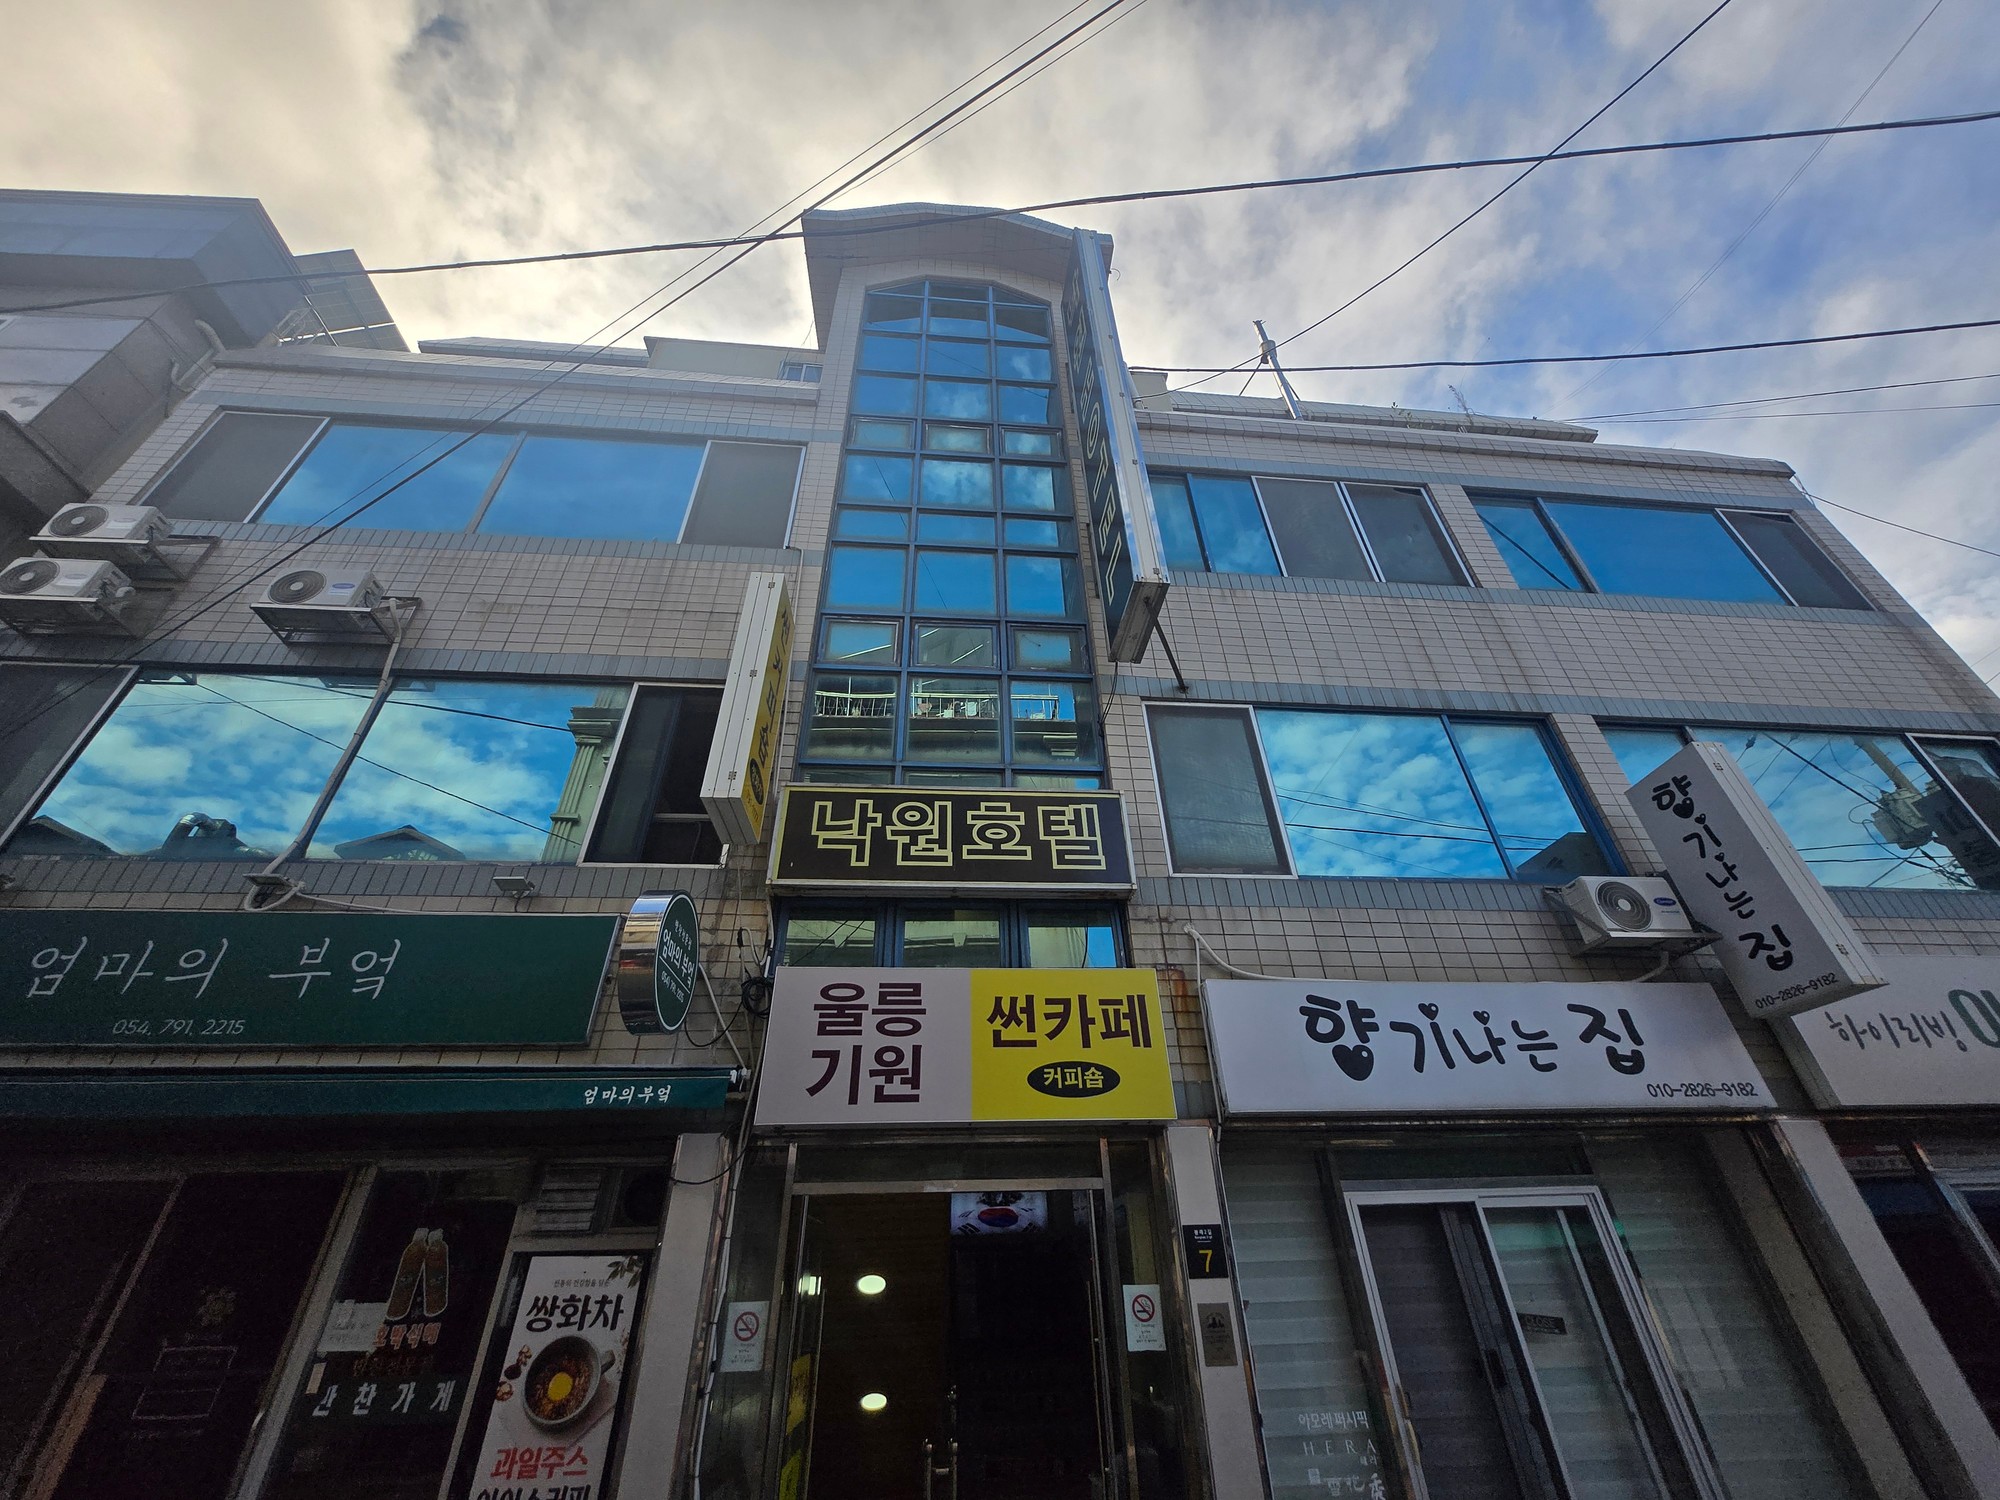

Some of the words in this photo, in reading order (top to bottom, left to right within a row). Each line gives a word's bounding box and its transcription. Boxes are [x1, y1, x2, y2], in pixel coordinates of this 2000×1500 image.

[1080, 356, 1122, 606] HOTEL
[811, 799, 1107, 870] 낙원호텔
[26, 936, 228, 999] 엄마의
[269, 937, 402, 999] 부엌
[663, 929, 683, 968] 엄마의
[682, 954, 696, 988] 부엌
[813, 982, 927, 1038] 울릉
[1755, 973, 1840, 1009] 010-2826-9182
[201, 1019, 246, 1035] 2215
[986, 994, 1153, 1049] 썬카페
[1824, 1010, 1968, 1052] 하이리빙
[805, 1044, 923, 1105] 기원
[1043, 1066, 1104, 1089] 커피숍
[1647, 1081, 1758, 1099] 010-2826-9182
[1198, 1249, 1213, 1273] 7
[525, 1293, 624, 1333] 쌍화차
[1298, 1410, 1370, 1430] 아모레퍼시픽
[490, 1446, 588, 1480] 과일주스
[1303, 1438, 1377, 1456] HERA
